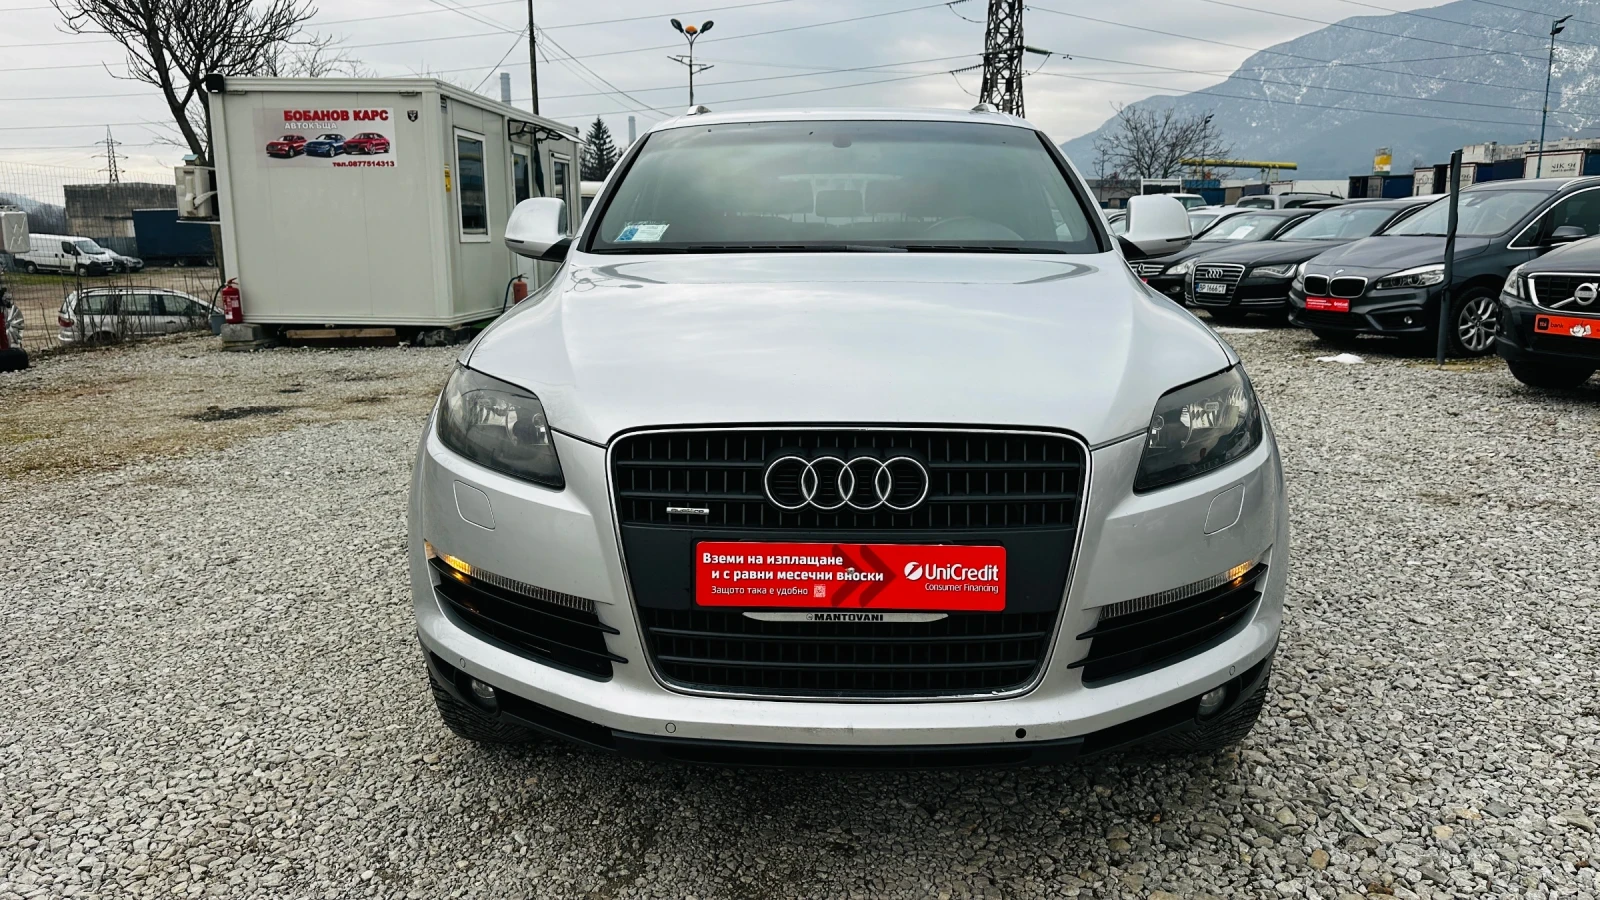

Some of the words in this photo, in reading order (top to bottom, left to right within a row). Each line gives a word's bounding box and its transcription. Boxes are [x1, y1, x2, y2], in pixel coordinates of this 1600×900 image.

[283, 109, 350, 121] БОБАНОВ
[353, 109, 389, 121] КАРС
[284, 121, 338, 130] АВТОКЪЩА
[702, 552, 744, 564] Вземи
[747, 555, 764, 565] на
[766, 555, 844, 567] изплащане
[711, 570, 720, 579] и
[723, 570, 731, 579] с
[733, 570, 774, 582] равни
[777, 570, 833, 580] месечни
[836, 571, 884, 581] вноски
[925, 563, 999, 581] UniCredit
[711, 585, 745, 595] Защото
[747, 587, 767, 595] така
[769, 587, 775, 595] е
[776, 586, 809, 596] удобно
[924, 582, 962, 592] Consumer
[963, 583, 999, 594] Financing
[814, 613, 884, 622] MANTOVANI
